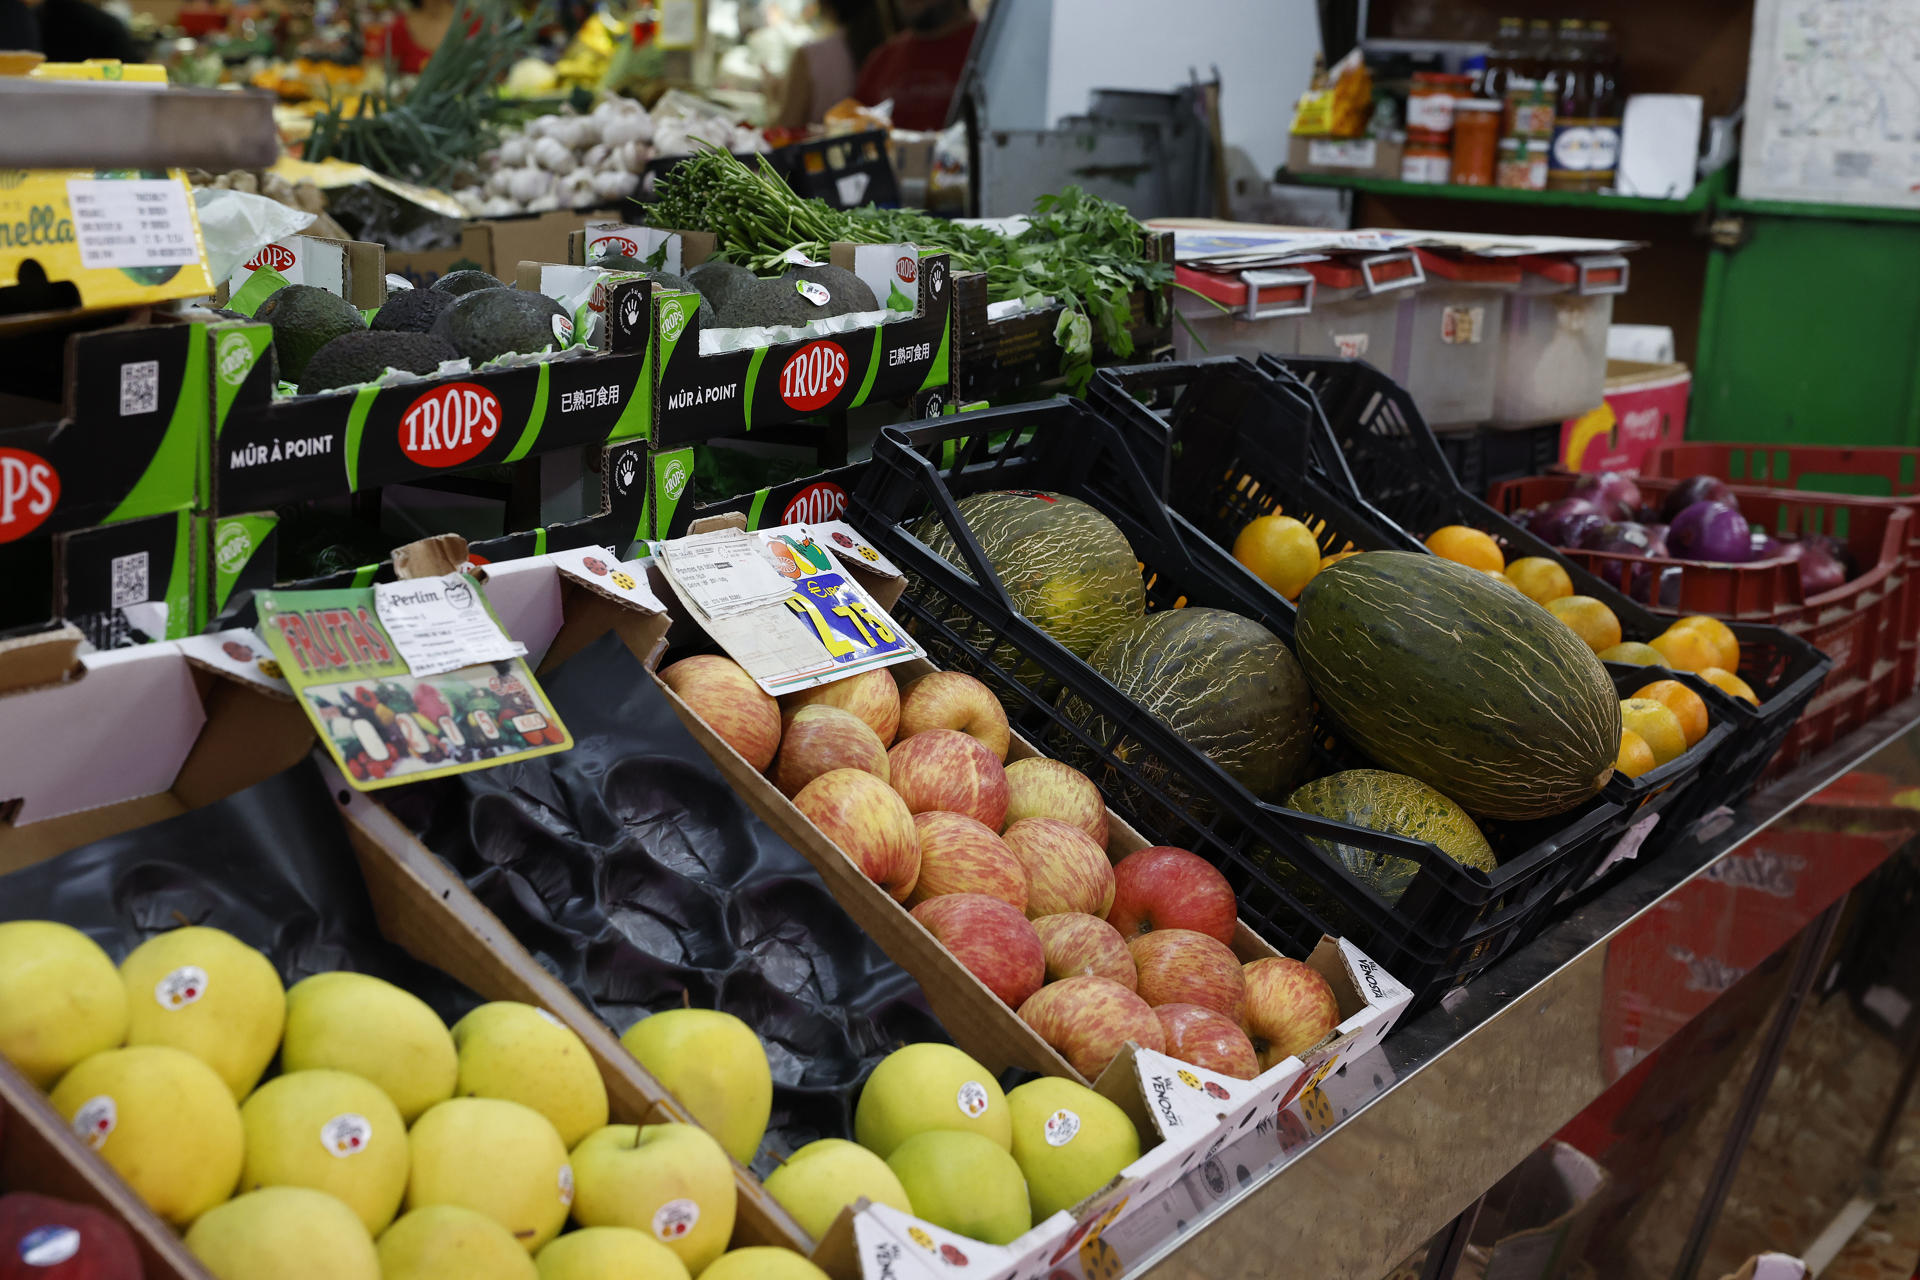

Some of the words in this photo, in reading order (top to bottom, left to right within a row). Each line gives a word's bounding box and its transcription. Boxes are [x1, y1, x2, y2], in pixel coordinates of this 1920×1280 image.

[249, 247, 293, 267] ROPS
[662, 310, 684, 334] TROPS
[889, 343, 930, 366] 已熟可食用
[784, 346, 846, 398] TROPS
[561, 384, 620, 413] 已熟可食用
[668, 388, 695, 410] MÛR
[696, 385, 703, 404] À
[705, 383, 737, 403] POINT
[404, 389, 498, 451] TROPS
[230, 442, 268, 469] MÛR
[270, 438, 283, 462] À
[285, 434, 334, 460] POINT
[1, 456, 52, 524] PS
[665, 470, 686, 494] TROPS
[391, 590, 440, 608] Perlim
[277, 606, 392, 672] FRUTAS
[1358, 959, 1383, 998] VENOSTA
[1152, 1075, 1178, 1127] VENOSTA
